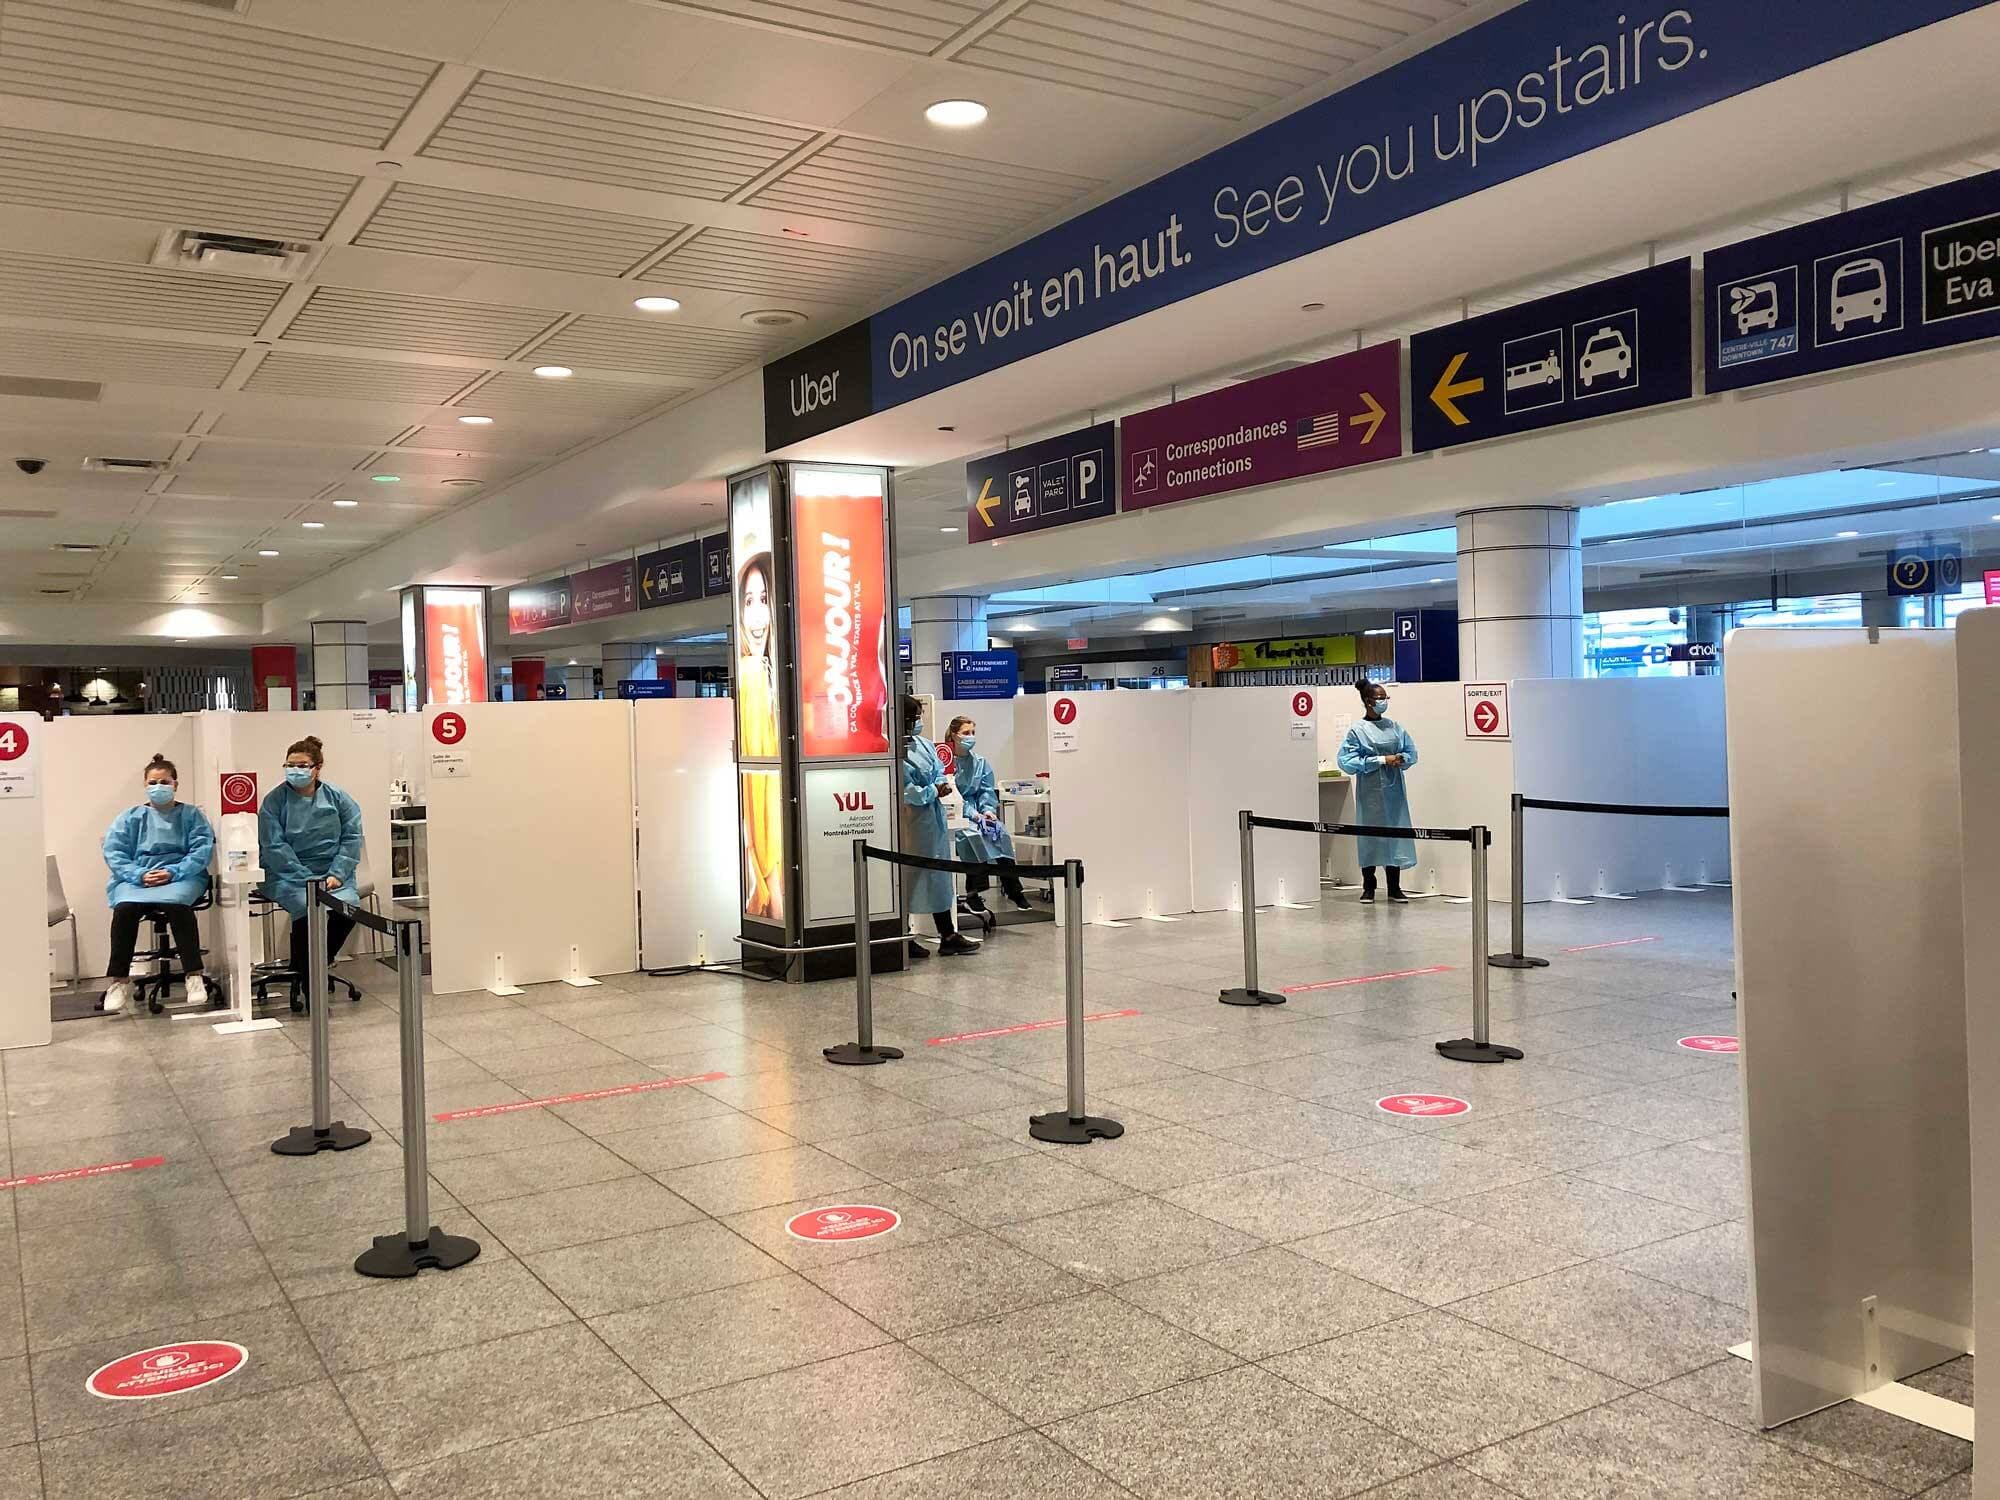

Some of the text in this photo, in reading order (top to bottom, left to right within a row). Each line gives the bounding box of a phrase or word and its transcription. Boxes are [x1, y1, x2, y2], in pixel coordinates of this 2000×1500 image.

[888, 8, 1710, 379] On se voit en haut. See you upstairs.
[1946, 276, 1994, 305] Eva
[1722, 338, 1769, 355] CENTRE-VILLE
[1770, 334, 1795, 351] 747
[1722, 349, 1764, 363] DOWNTOWN
[790, 367, 841, 417] Uber
[1166, 418, 1288, 461] Correspondances
[1080, 460, 1097, 499] P
[1166, 456, 1252, 487] Connections
[1042, 475, 1066, 488] VALET
[1044, 487, 1064, 498] PARC
[854, 600, 862, 611] AT
[854, 613, 862, 645] STARTS
[1254, 640, 1325, 659] Fleuriste
[1290, 658, 1325, 666] FLORIST
[1152, 666, 1165, 676] 26
[1060, 704, 1070, 719] 7
[1298, 697, 1308, 711] 8
[442, 718, 457, 738] 5
[0, 730, 17, 752] 4
[833, 792, 874, 811] YUL
[823, 829, 874, 837] Montréal-Trudeau
[1415, 829, 1430, 838] YUL
